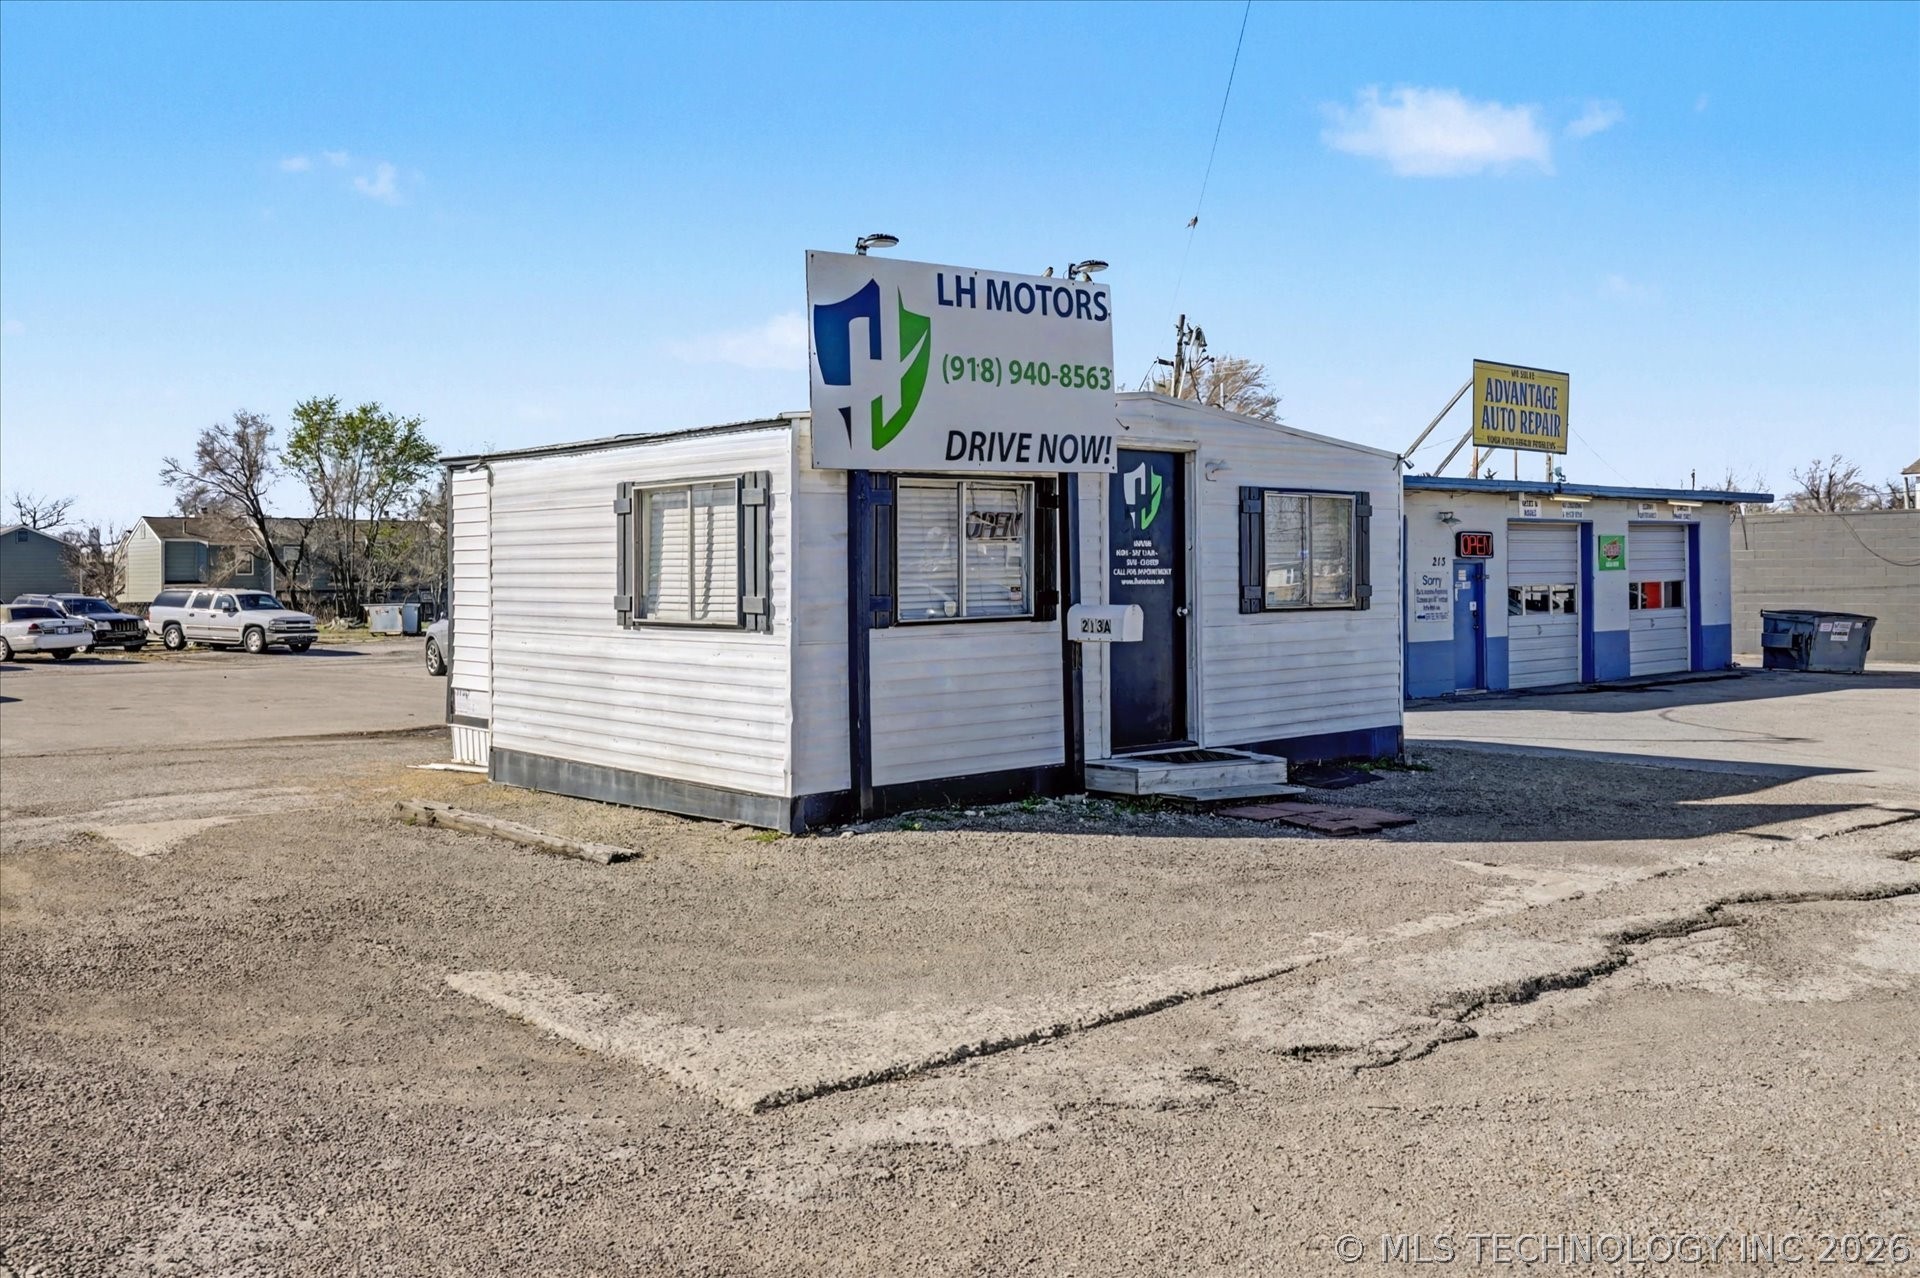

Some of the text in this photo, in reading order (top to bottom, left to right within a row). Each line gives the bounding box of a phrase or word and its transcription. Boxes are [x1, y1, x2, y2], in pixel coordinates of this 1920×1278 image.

[937, 273, 1109, 322] LH MOTORS
[942, 354, 1111, 390] (918) 940-8563
[1485, 377, 1558, 411] ADVANTAGE
[1481, 405, 1561, 438] AUTO REPAIR
[945, 430, 1113, 464] DRIVE NOW!
[967, 511, 1023, 541] OPEN
[1462, 535, 1492, 555] OPEN
[1422, 574, 1442, 588] Sorry
[1081, 618, 1112, 634] 213A
